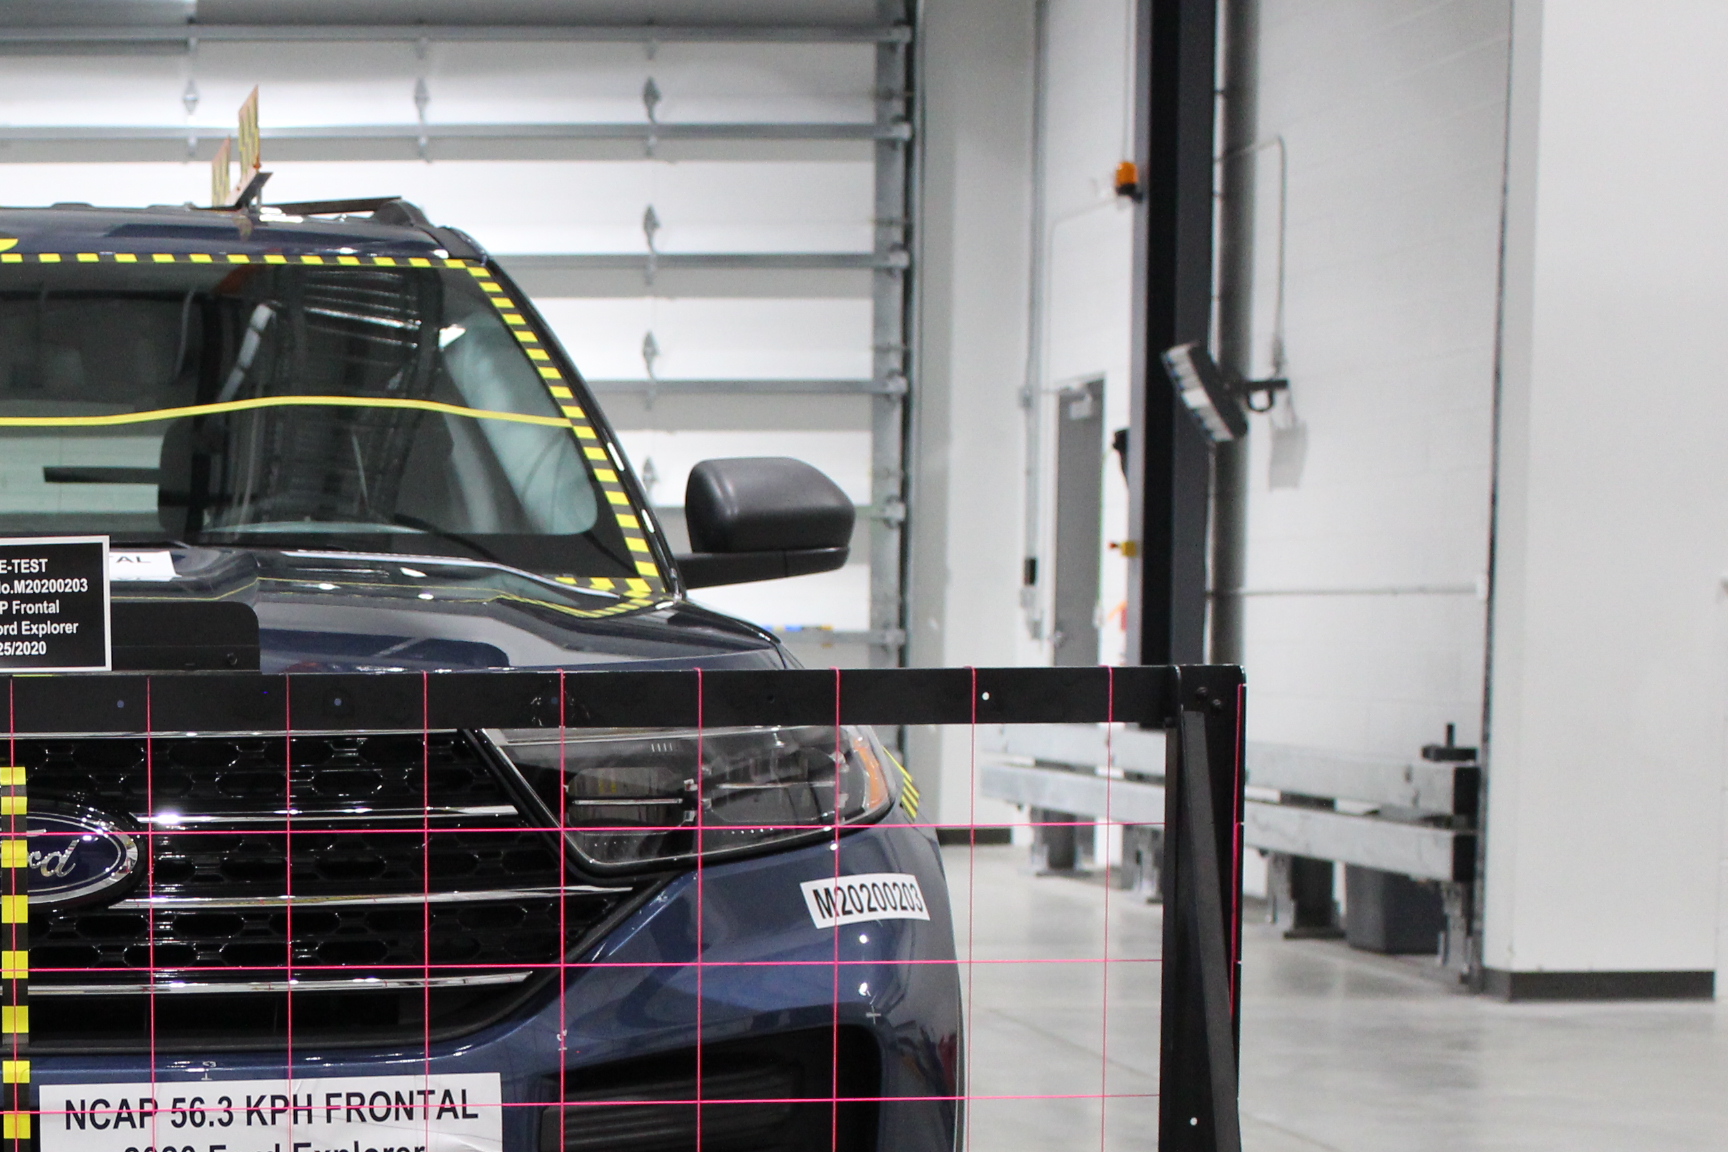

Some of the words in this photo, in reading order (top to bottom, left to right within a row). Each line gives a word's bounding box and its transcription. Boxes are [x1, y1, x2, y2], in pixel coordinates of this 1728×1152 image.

[12, 599, 60, 615] Frontal
[21, 620, 79, 638] Explorer
[812, 881, 923, 919] M20200203
[65, 1098, 159, 1131] NCAP
[170, 1096, 235, 1129] 56.3
[246, 1093, 314, 1127] KPH
[326, 1088, 479, 1124] FRONTAL
